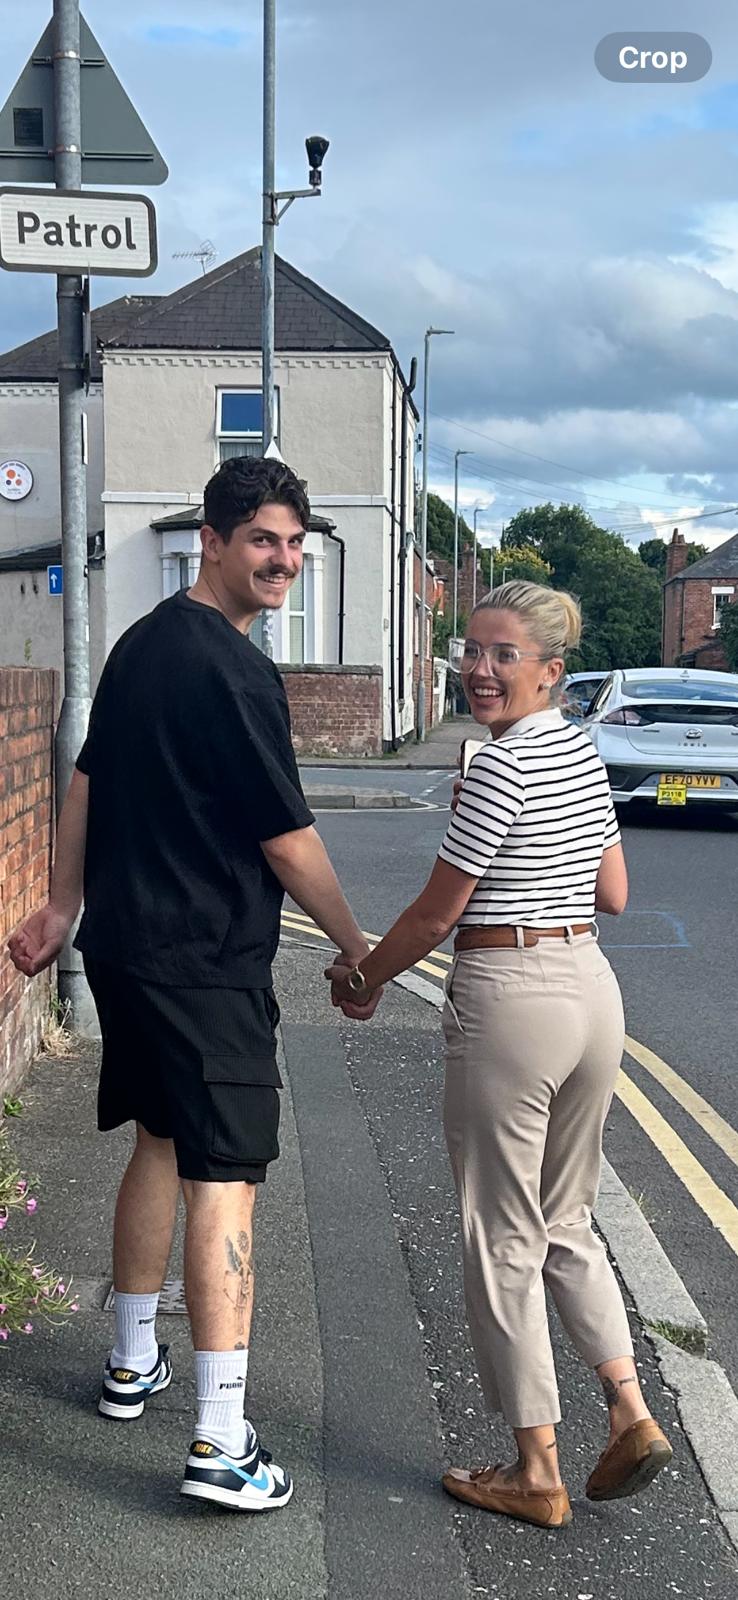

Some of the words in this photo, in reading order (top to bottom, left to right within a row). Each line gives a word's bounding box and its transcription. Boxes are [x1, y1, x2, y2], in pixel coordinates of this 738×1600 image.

[17, 211, 137, 250] Patrol
[665, 774, 693, 785] EF70
[695, 775, 716, 786] YVV
